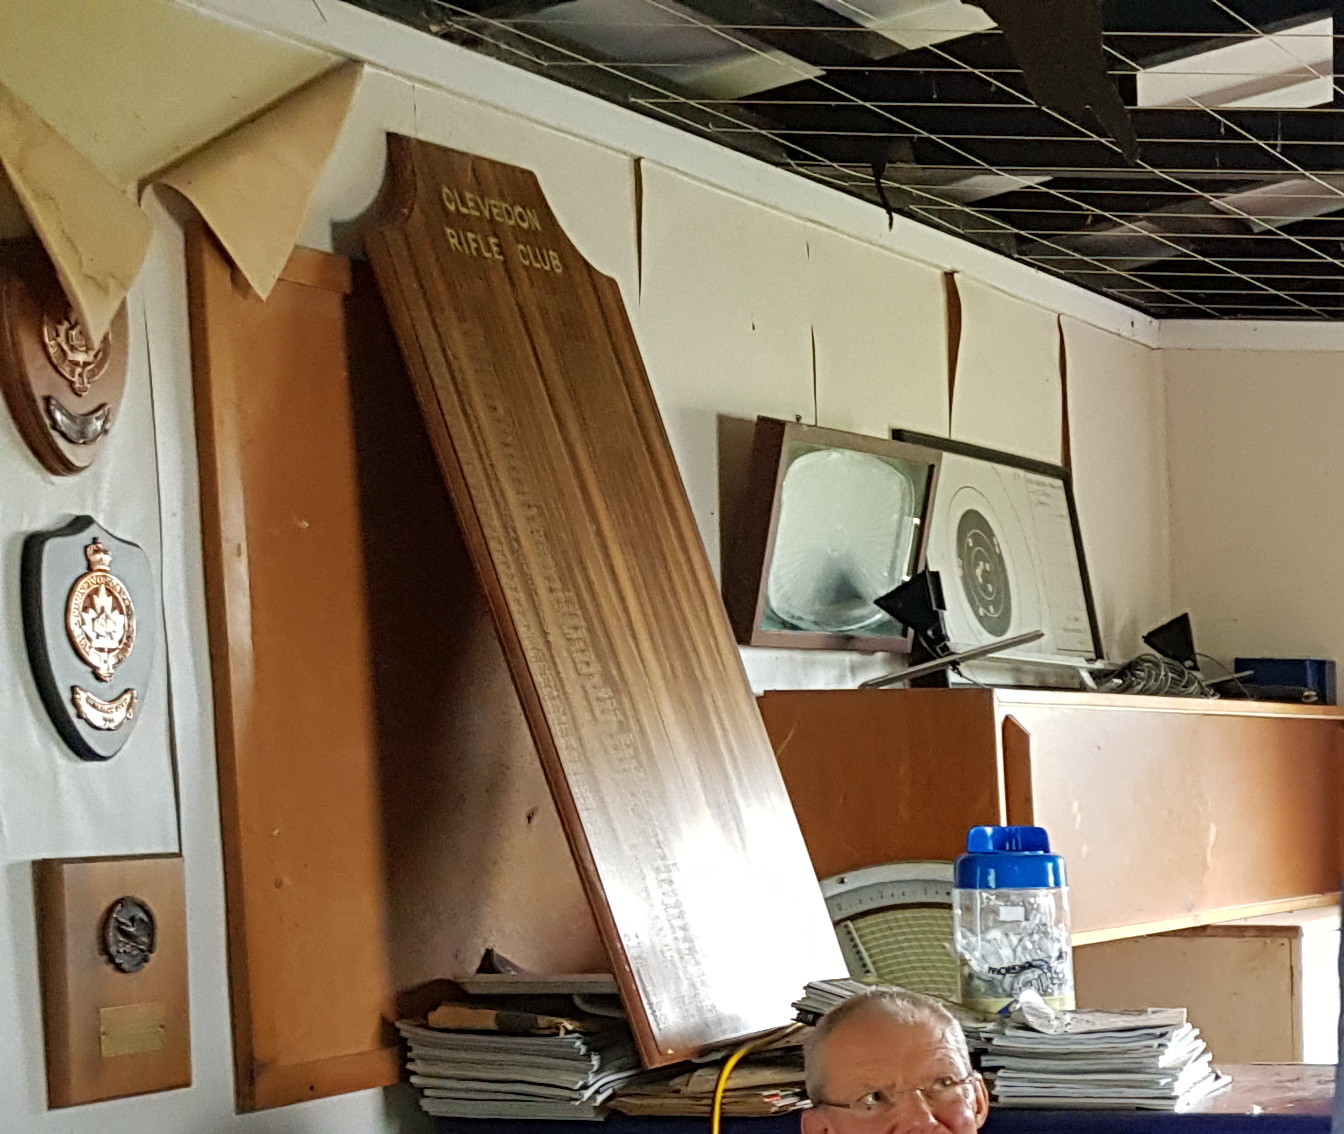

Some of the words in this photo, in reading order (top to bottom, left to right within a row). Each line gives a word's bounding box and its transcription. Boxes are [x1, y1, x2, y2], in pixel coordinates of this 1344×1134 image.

[442, 184, 542, 232] CLEVEDON
[444, 226, 504, 261] RIFLE
[518, 243, 563, 273] CLUB
